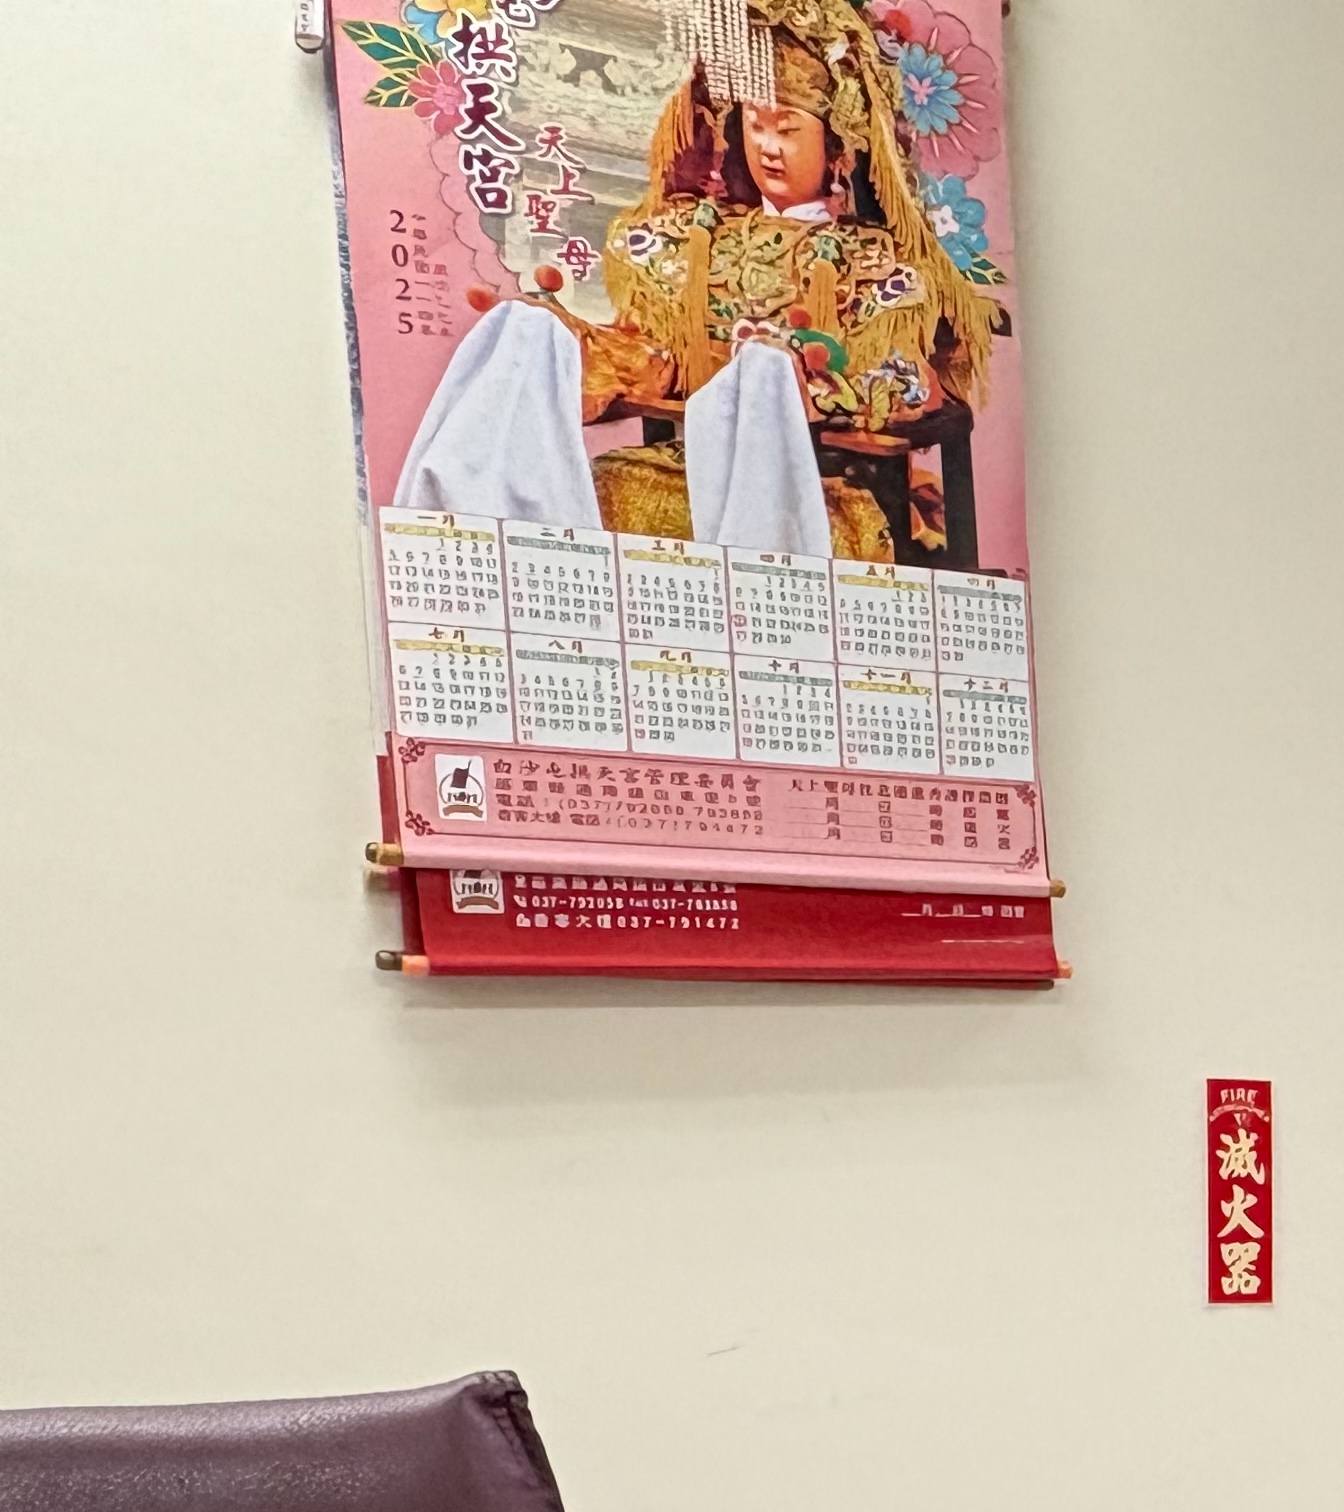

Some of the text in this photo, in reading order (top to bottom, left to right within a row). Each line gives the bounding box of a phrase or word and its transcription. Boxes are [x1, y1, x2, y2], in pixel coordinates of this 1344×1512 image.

[449, 9, 526, 213] 拱天宮
[389, 209, 414, 335] 2025
[523, 125, 600, 281] 天上聖母
[1215, 1127, 1266, 1296] 滅火器
